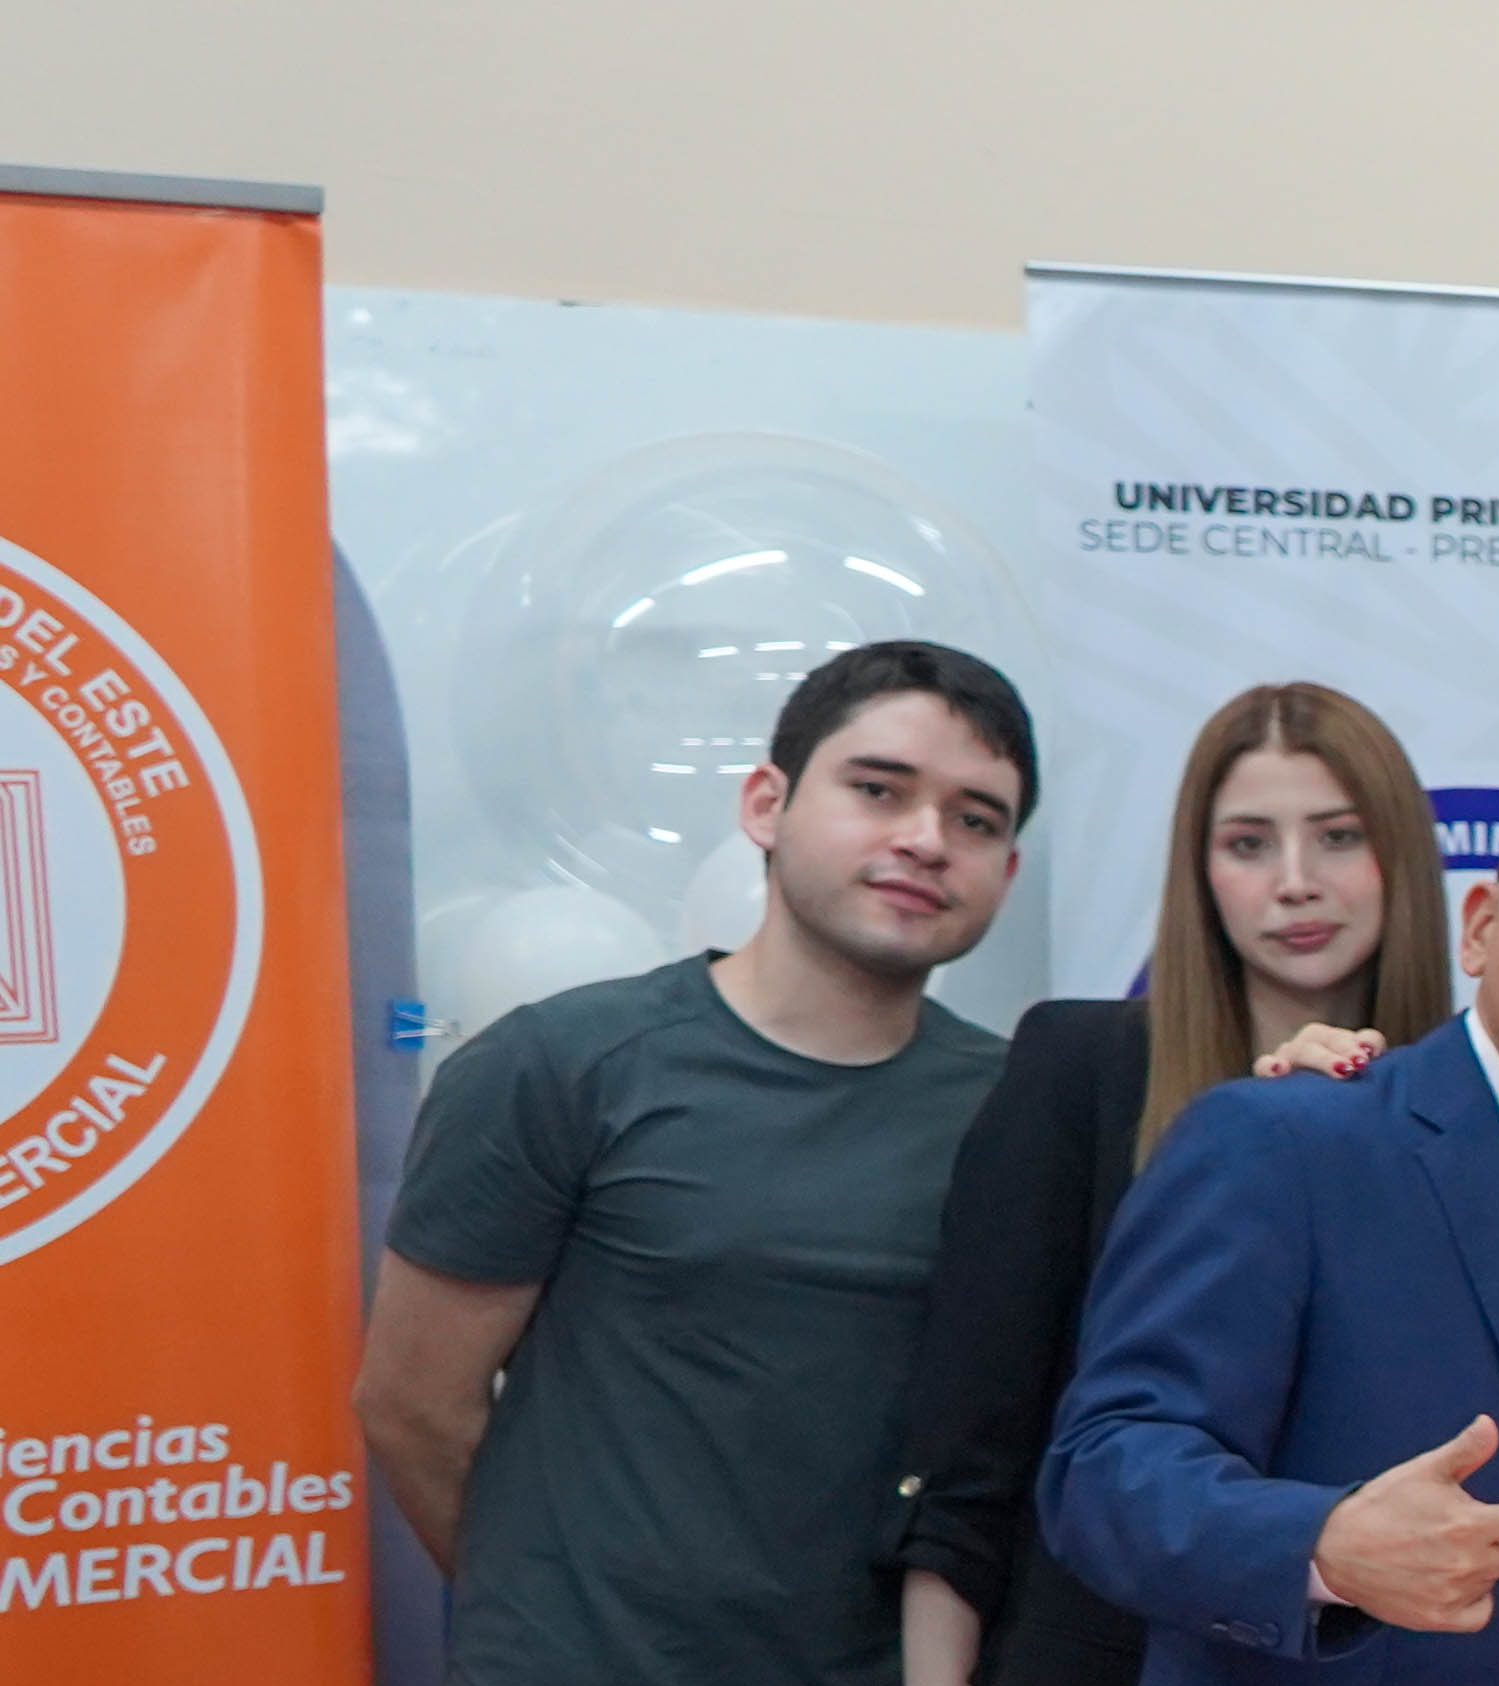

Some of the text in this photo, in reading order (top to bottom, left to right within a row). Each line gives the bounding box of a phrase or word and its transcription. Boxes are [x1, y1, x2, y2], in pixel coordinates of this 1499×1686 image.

[1114, 482, 1415, 522] UNIVERSIDAD
[1079, 519, 1190, 556] SEDE
[1202, 524, 1393, 563] CENTRAL
[40, 684, 157, 856] CONTABLES
[79, 667, 190, 797] ESTE
[3, 1461, 354, 1537] Contables
